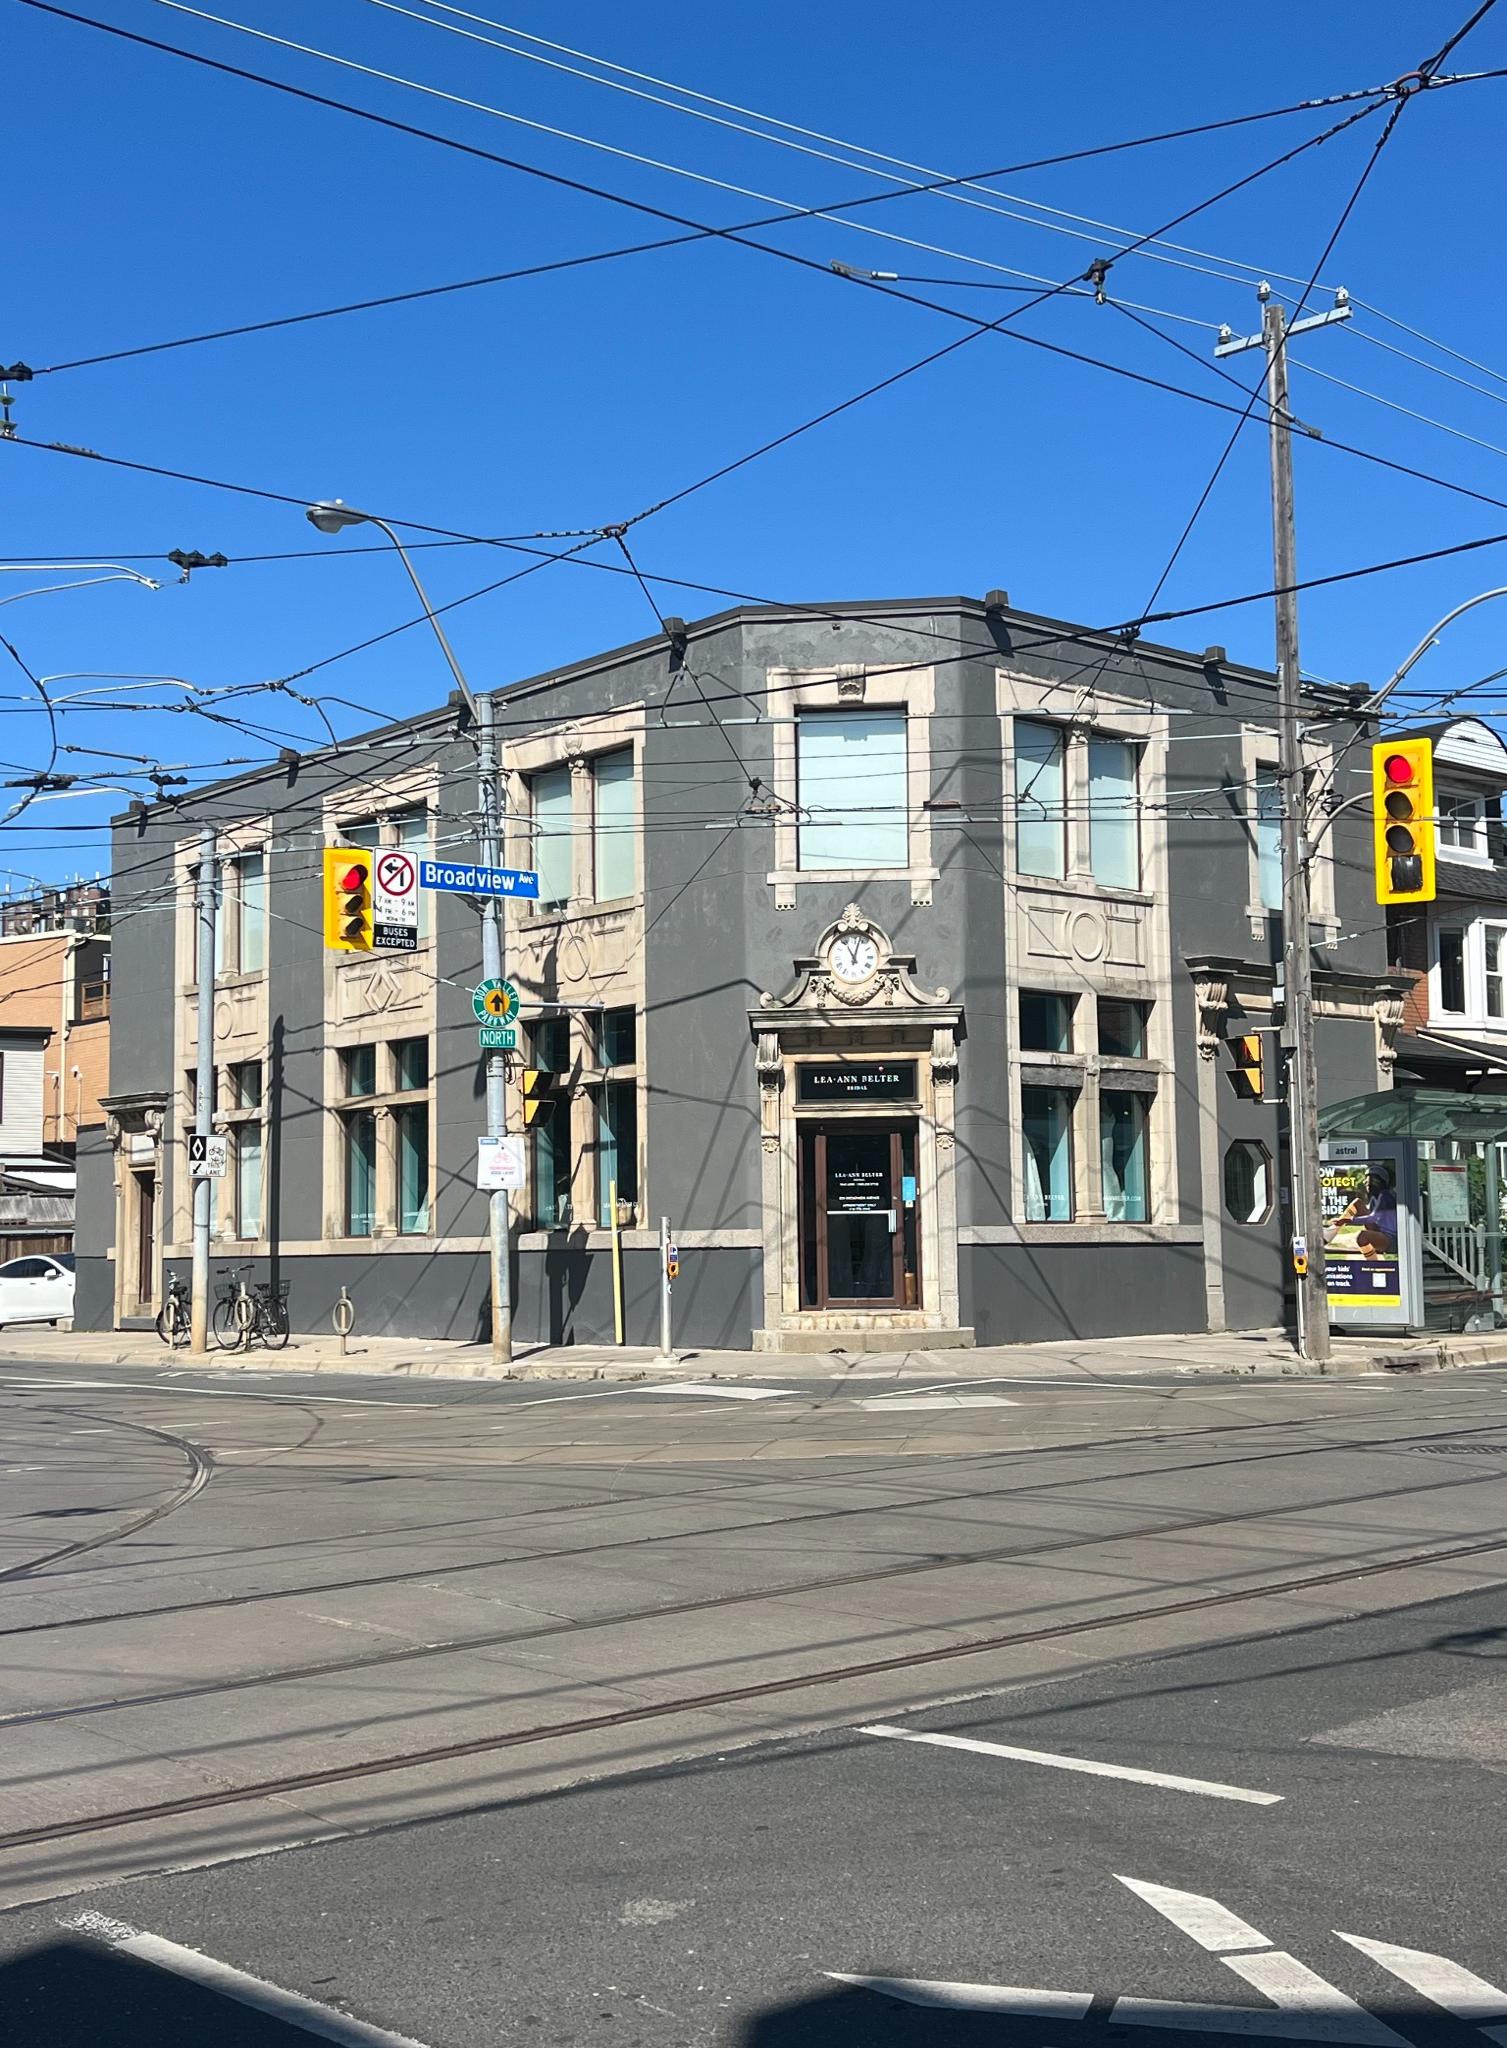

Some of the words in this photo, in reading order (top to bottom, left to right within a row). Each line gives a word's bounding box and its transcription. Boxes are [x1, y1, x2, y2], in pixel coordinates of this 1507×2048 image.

[425, 863, 515, 890] Broadview
[518, 874, 535, 885] Ave
[401, 898, 406, 906] 9
[383, 926, 409, 937] BUSES
[376, 936, 416, 948] EXCEPTED
[474, 983, 490, 1001] DON
[492, 979, 519, 1002] VALLEY
[477, 1009, 516, 1027] PARKWAY
[482, 1030, 515, 1046] NORTH
[861, 1074, 901, 1084] BELTER
[1335, 1146, 1359, 1155] astral
[1321, 1177, 1356, 1187] OTECT
[1321, 1187, 1338, 1197] EM
[1329, 1195, 1348, 1206] THE
[1321, 1205, 1345, 1215] SIDE
